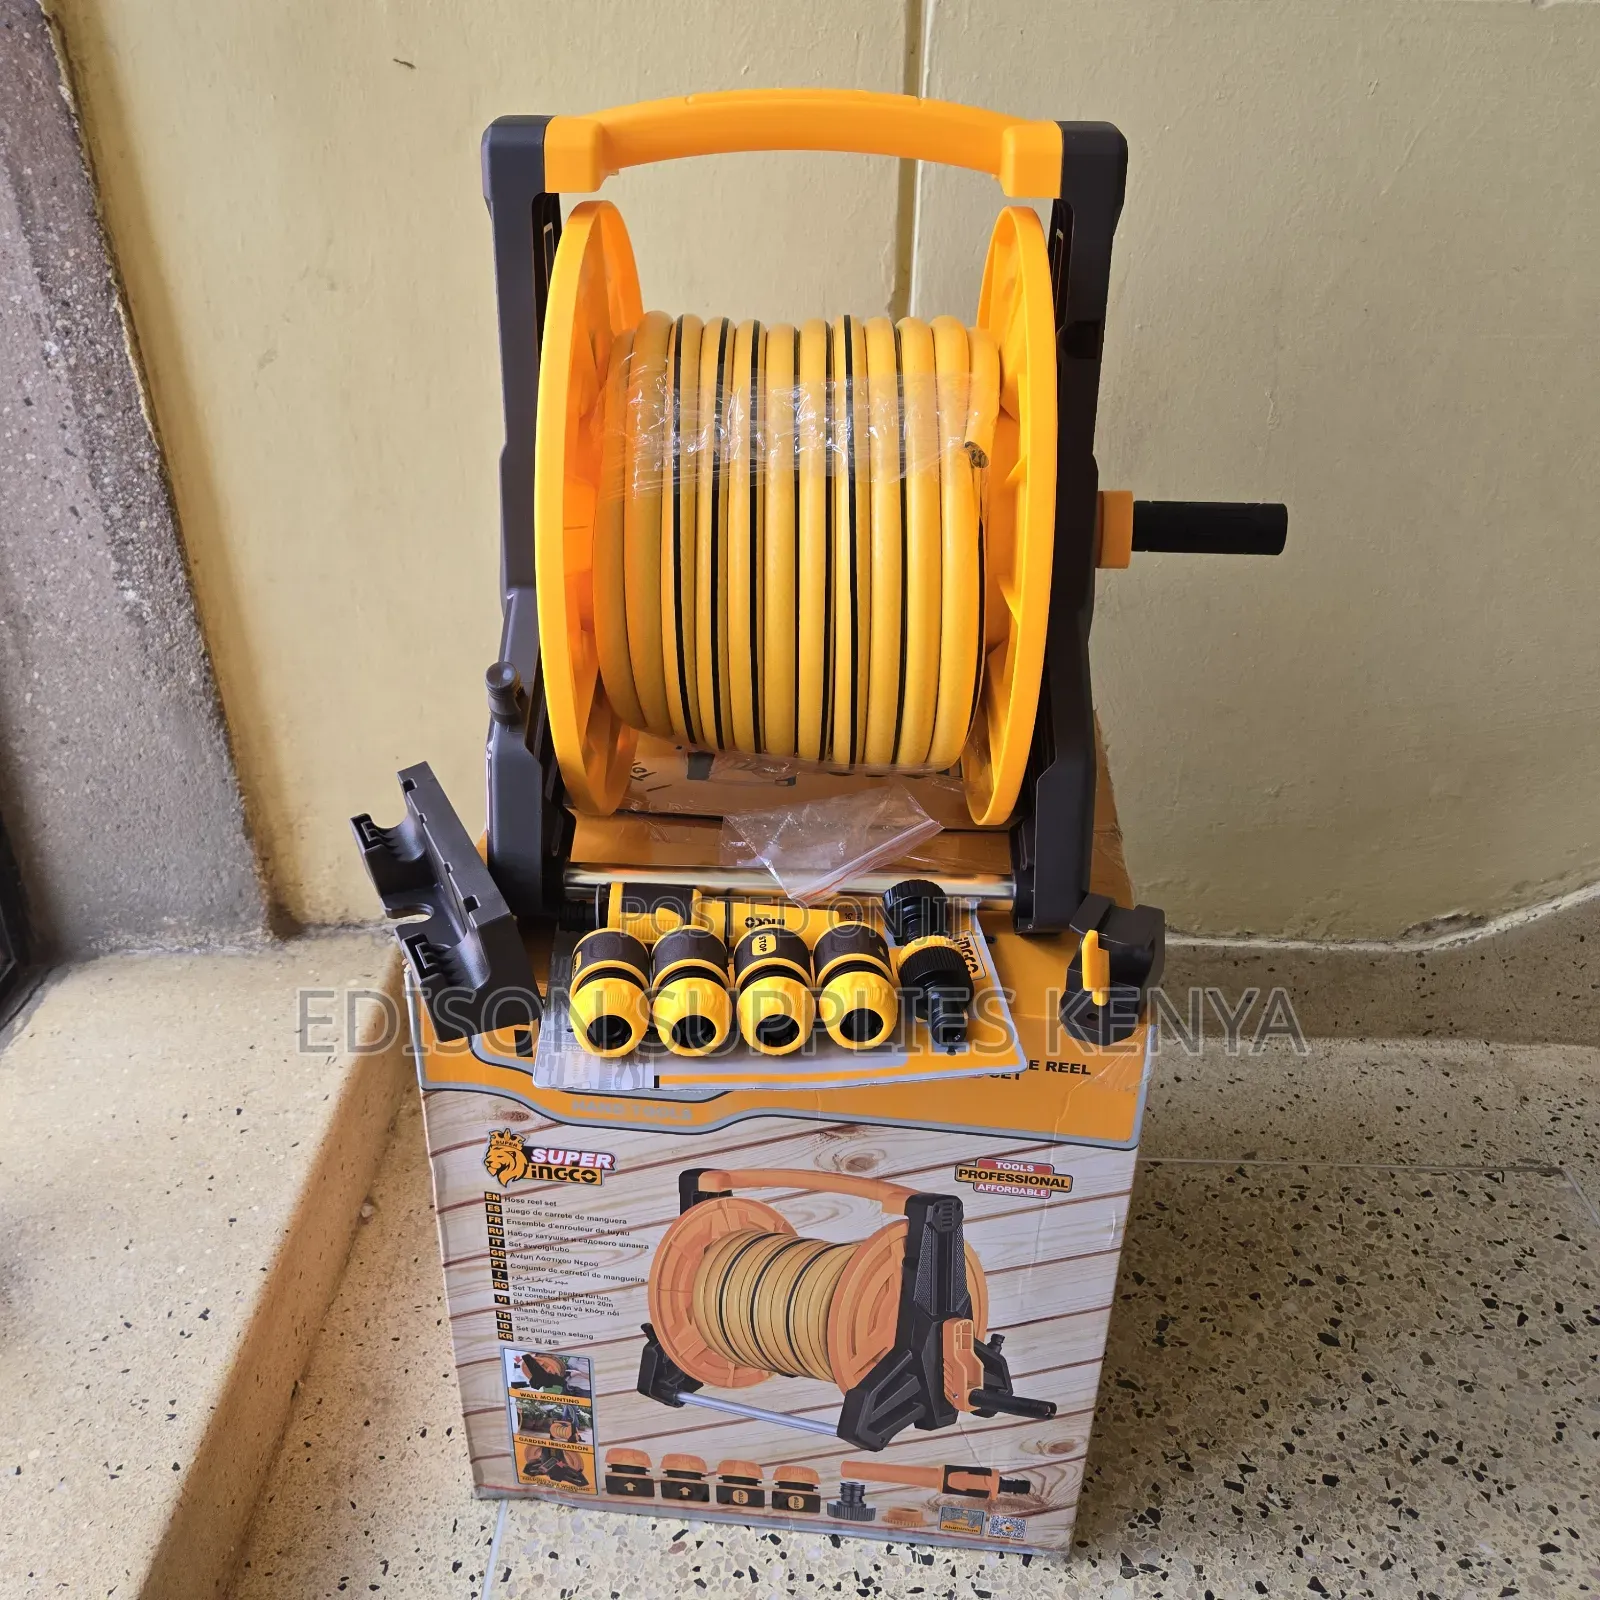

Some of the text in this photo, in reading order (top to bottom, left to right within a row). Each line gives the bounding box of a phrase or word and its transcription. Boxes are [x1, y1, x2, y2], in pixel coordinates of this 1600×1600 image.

[759, 935, 767, 952] STOP
[1045, 1061, 1091, 1076] REEL
[571, 1099, 692, 1121] HAND TOOLS
[531, 1148, 613, 1169] SUPER
[995, 1161, 1035, 1172] TOOLS
[958, 1168, 1068, 1188] PROFESSIONAL
[486, 1193, 500, 1201] EN
[977, 1183, 1047, 1197] AFFORDABLE
[487, 1205, 501, 1213] ES
[506, 1207, 530, 1216] Juego
[545, 1211, 573, 1219] carrete
[587, 1215, 627, 1225] manguera
[488, 1216, 501, 1224] FR
[506, 1218, 546, 1228] Ensemble
[607, 1228, 630, 1237] tuyau
[489, 1227, 503, 1235] RU
[507, 1230, 533, 1238] Набор
[535, 1233, 569, 1243] катушки
[578, 1238, 617, 1247] садового
[491, 1250, 505, 1258] GR
[492, 1260, 505, 1268] PT
[510, 1263, 546, 1272] Conjunto
[560, 1268, 590, 1277] carretel
[603, 1274, 646, 1283] mangueira
[494, 1282, 508, 1290] RO
[527, 1286, 556, 1294] Tambur
[496, 1295, 508, 1303] VI
[571, 1297, 596, 1305] furtun
[496, 1312, 511, 1320] TH
[498, 1333, 513, 1341] KR
[530, 1327, 567, 1336] gulungan
[568, 1332, 594, 1340] selang
[520, 1391, 580, 1404] WALL MOUNTING
[518, 1437, 589, 1451] GARDEN IRRIGATION
